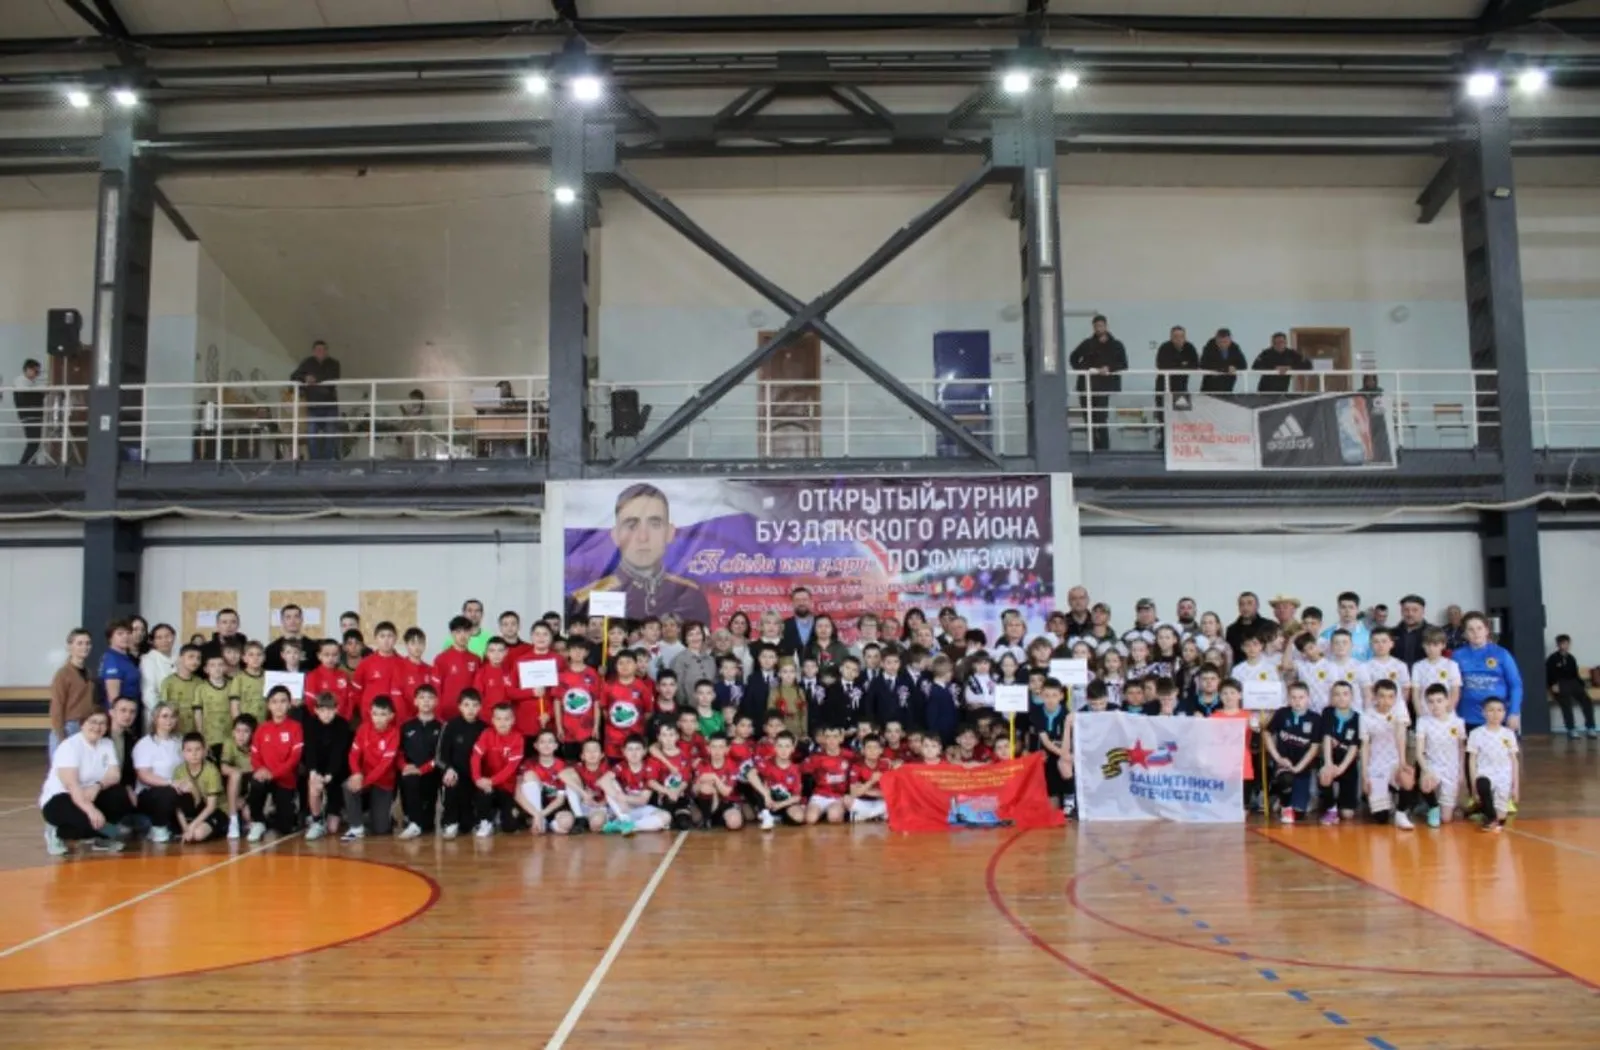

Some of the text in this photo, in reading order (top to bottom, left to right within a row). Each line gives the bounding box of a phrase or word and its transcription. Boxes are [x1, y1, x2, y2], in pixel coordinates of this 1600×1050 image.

[1172, 445, 1203, 458] NBA
[1267, 436, 1314, 450] adidas
[798, 482, 1039, 512] ОТКРЫТЫЙ ТУРНИР
[756, 511, 1040, 546] БУЗДЯКСКОГО РАЙОНА
[888, 549, 919, 572] ПО
[929, 547, 1040, 573] ФУТЗАЛУ
[1129, 771, 1224, 791] ЗАЩИТНИКИ
[1129, 785, 1212, 803] ОТЕЧЕСТВА
